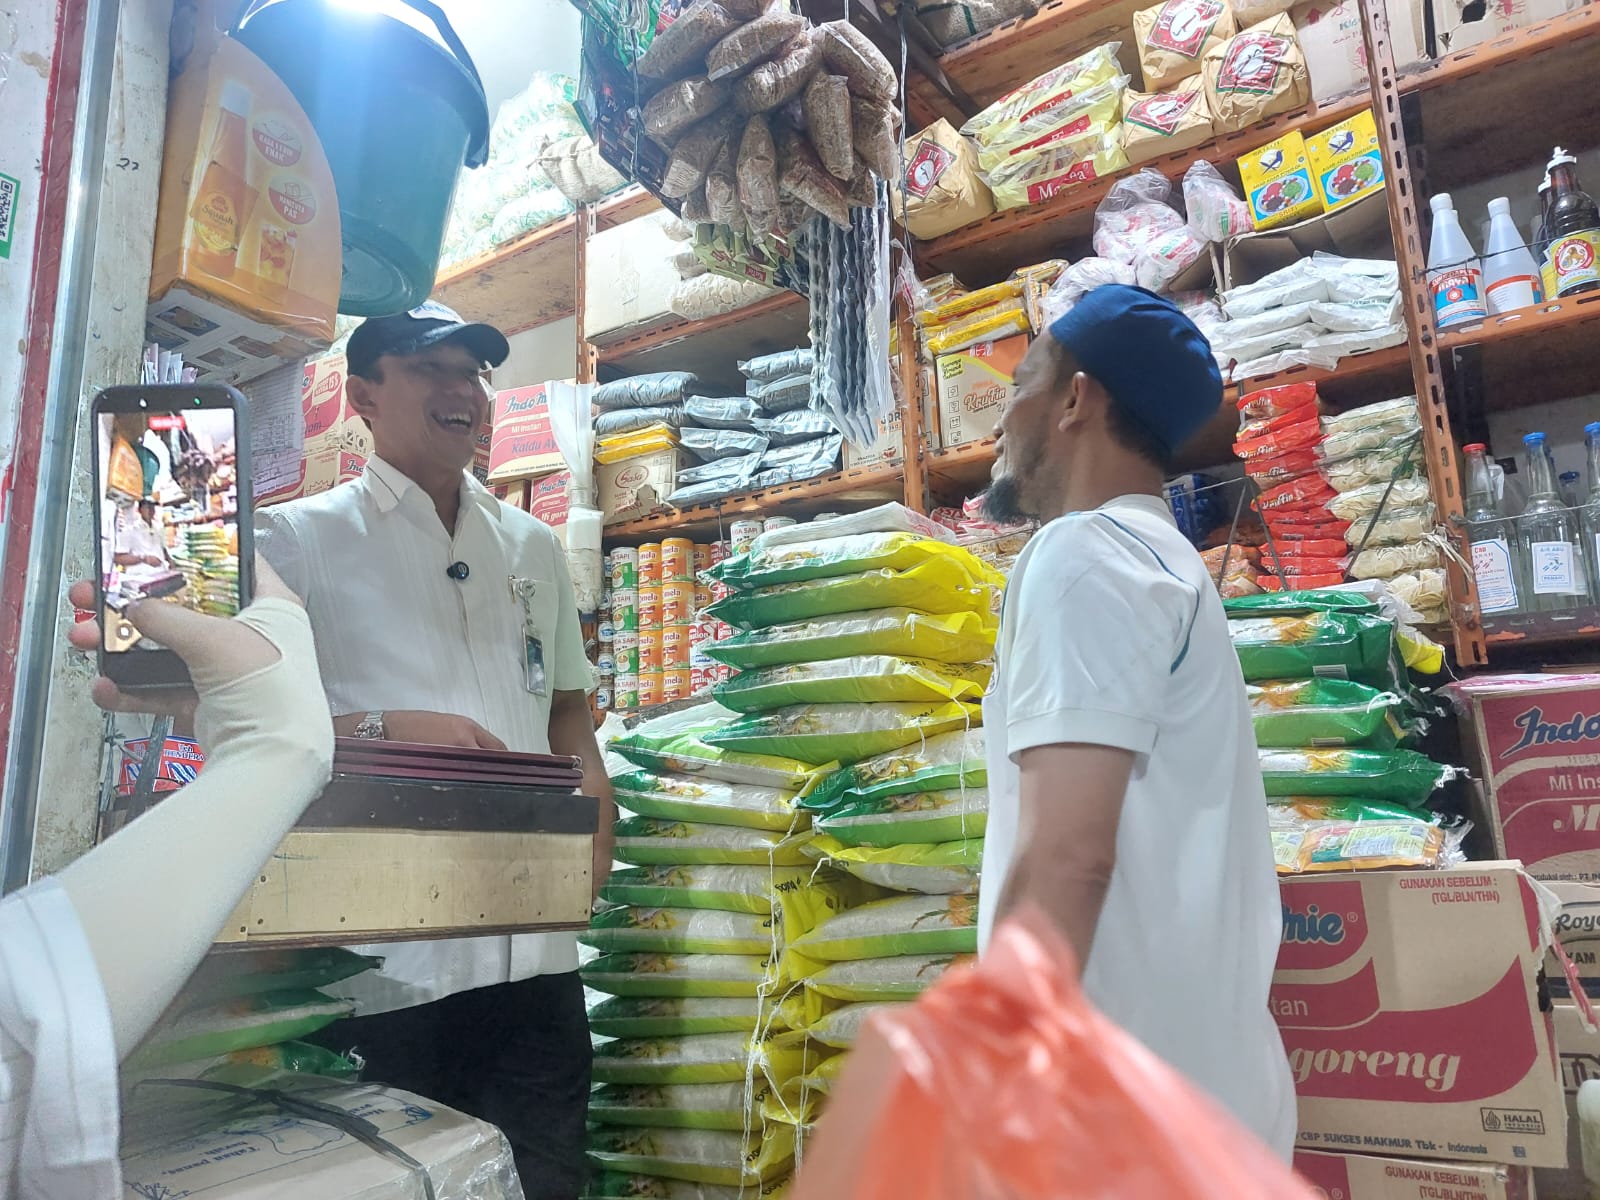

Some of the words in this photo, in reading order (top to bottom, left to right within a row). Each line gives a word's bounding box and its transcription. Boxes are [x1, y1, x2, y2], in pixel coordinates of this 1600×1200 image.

[1549, 775, 1573, 791] Mi
[1400, 877, 1445, 889] GUNAKAN
[1447, 875, 1492, 887] SEBELUM
[1432, 890, 1500, 905] (TGL/BLN/THN)
[1289, 1047, 1461, 1092] goreng
[1503, 1113, 1540, 1125] HALAL
[1301, 1131, 1321, 1141] CBP
[1323, 1133, 1361, 1145] SUKSES
[1363, 1136, 1412, 1149] MAKMUR
[1414, 1139, 1436, 1151] Tbk
[1385, 1165, 1432, 1183] GUNAKAN
[1433, 1171, 1479, 1188] SEBELUM
